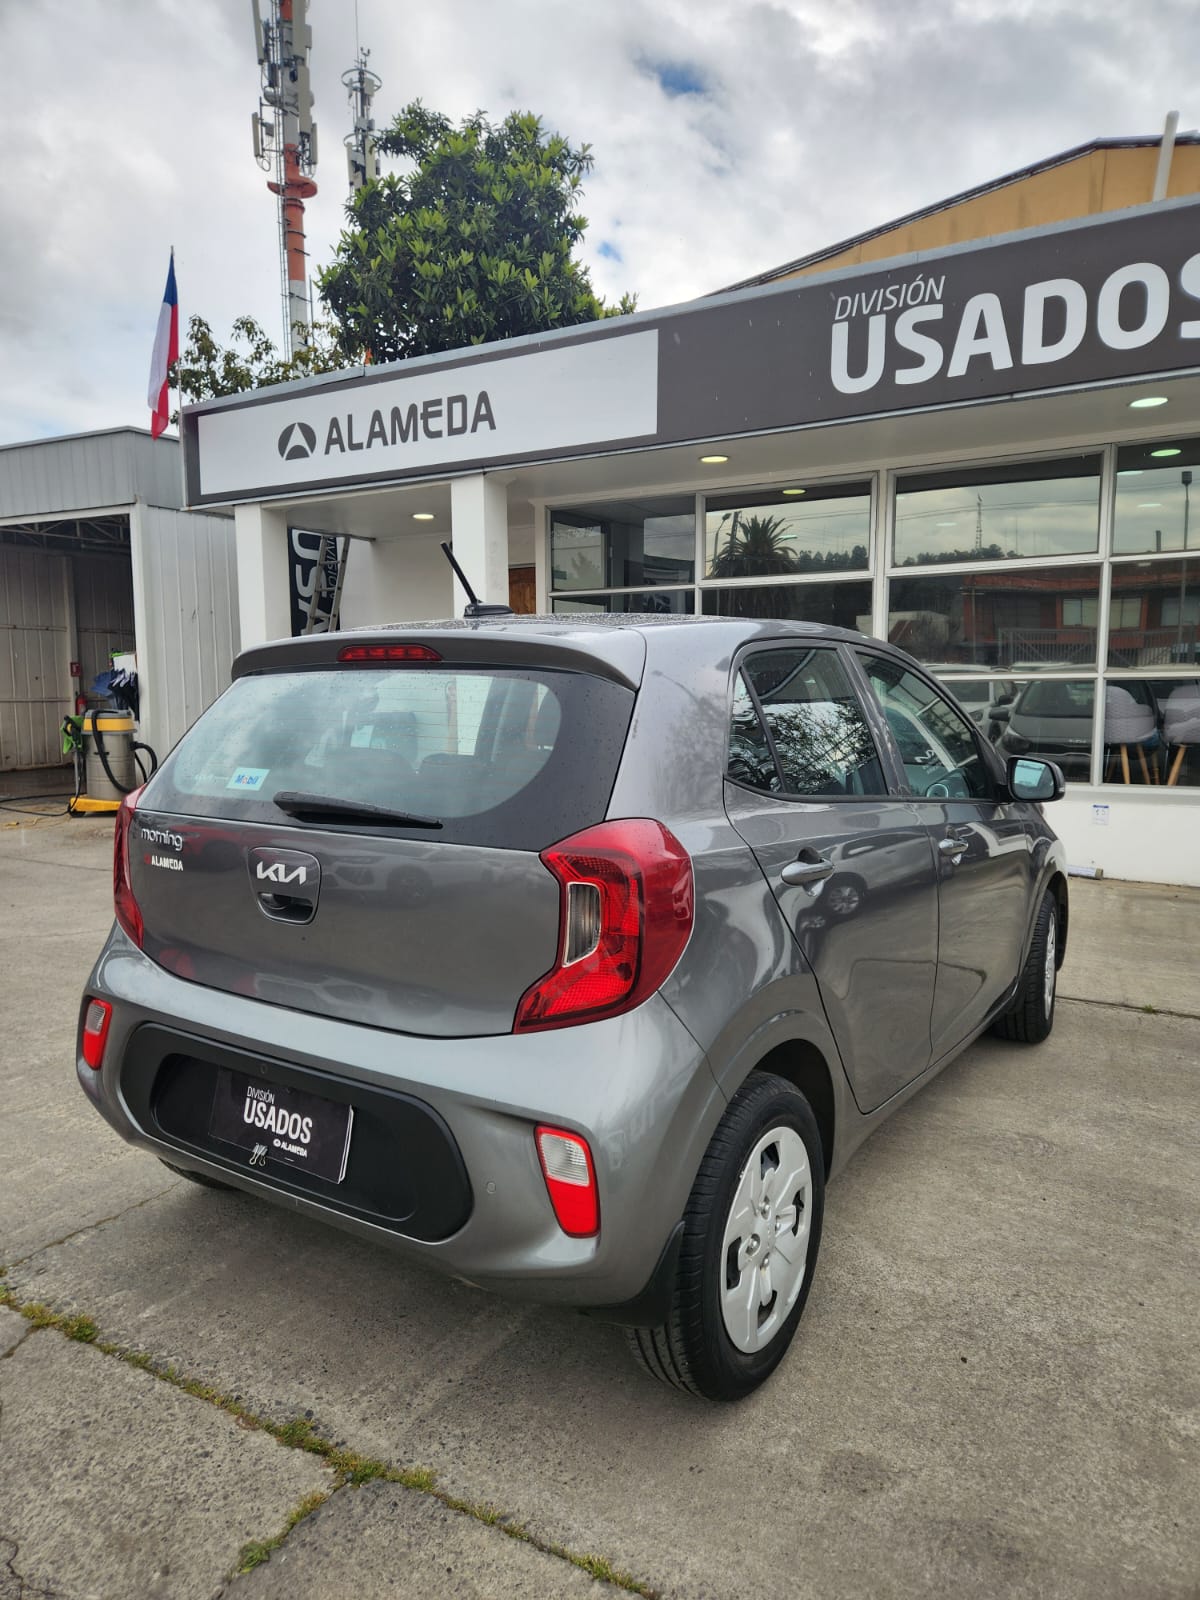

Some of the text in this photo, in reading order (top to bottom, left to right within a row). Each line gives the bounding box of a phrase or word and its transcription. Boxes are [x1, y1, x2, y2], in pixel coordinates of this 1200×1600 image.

[834, 273, 946, 321] DIVISIÓN
[324, 390, 497, 456] ALAMEDA
[141, 828, 183, 852] morning
[151, 855, 184, 871] ALAMEDA
[256, 861, 307, 885] KIA
[247, 1086, 275, 1104] DIVISIÓN
[243, 1098, 313, 1144] USADOS
[280, 1141, 308, 1158] ALAMEDA
